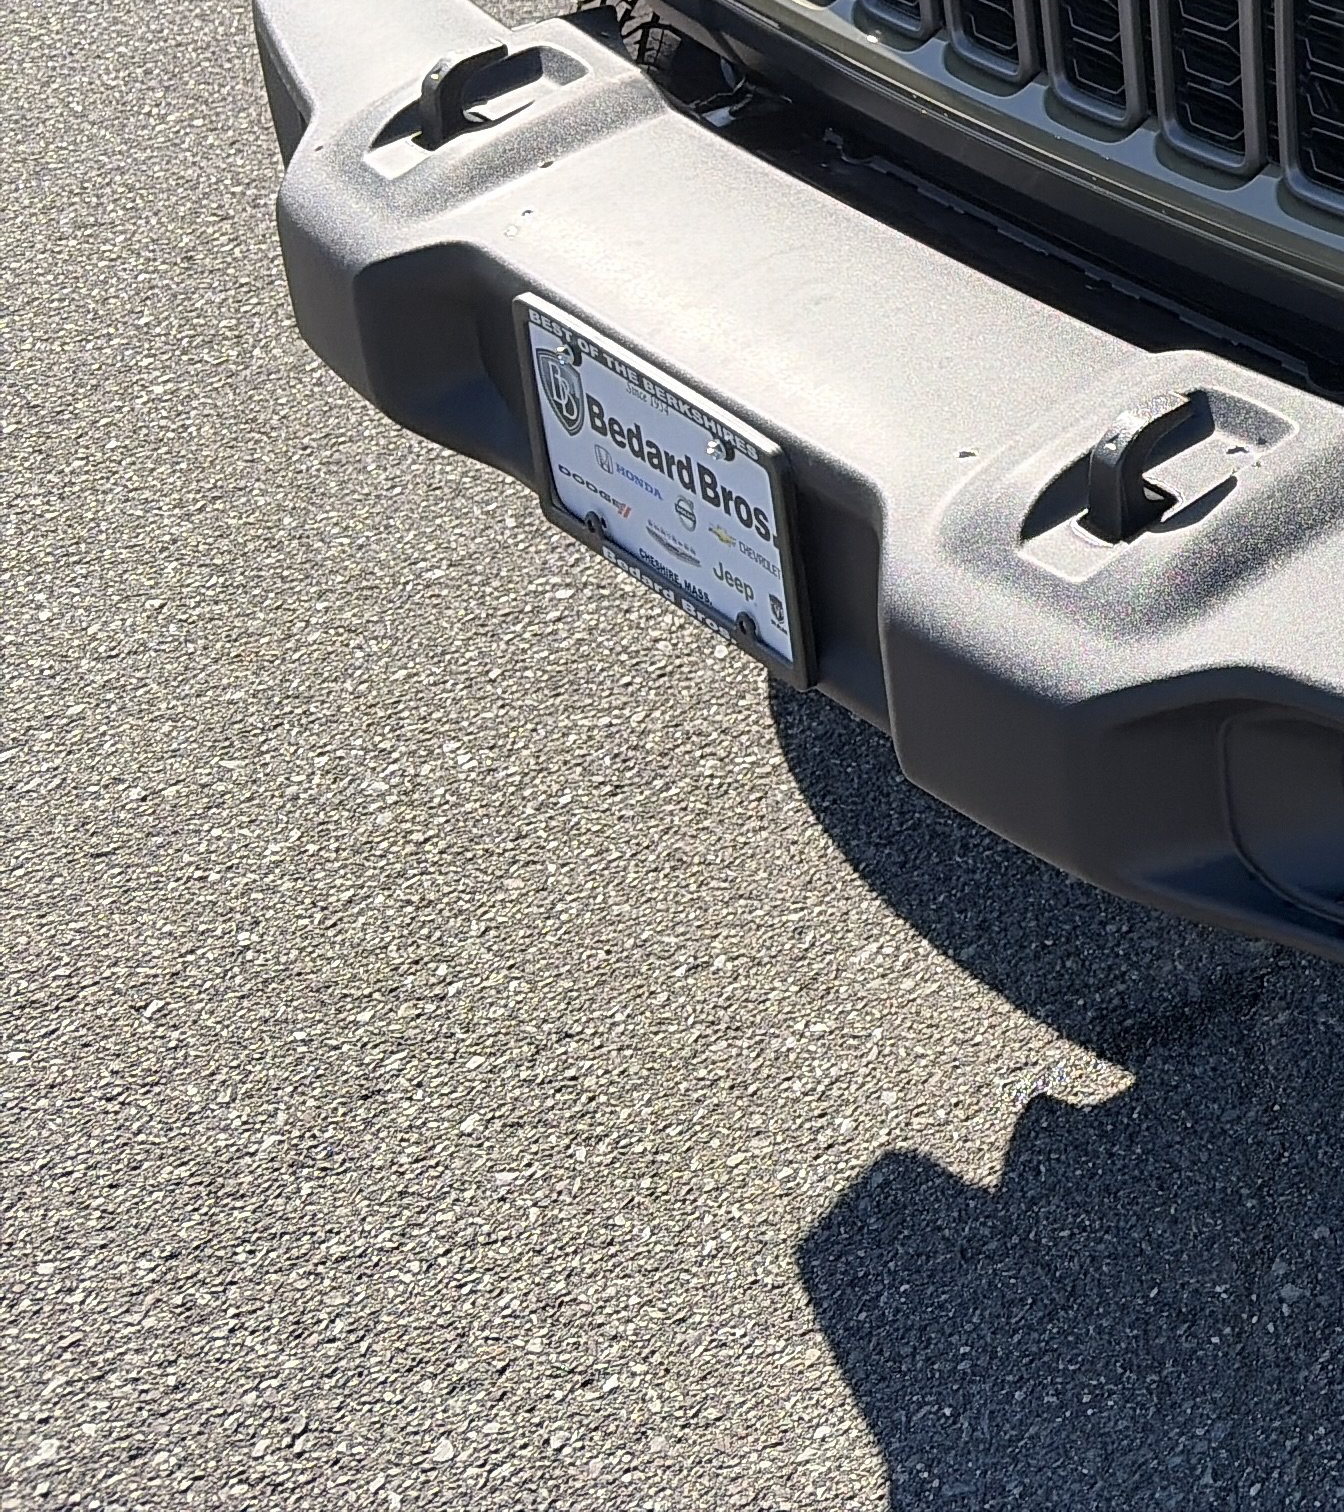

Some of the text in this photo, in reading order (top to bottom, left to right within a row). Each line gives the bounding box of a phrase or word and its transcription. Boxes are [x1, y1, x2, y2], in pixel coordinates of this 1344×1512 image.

[528, 309, 759, 461] BEST OF THE BERKSHIRES
[558, 464, 628, 508] DODGE
[616, 462, 663, 500] HONDA
[602, 546, 674, 602] Bedard
[713, 561, 754, 602] Jeep
[738, 541, 781, 580] CHEVROLET
